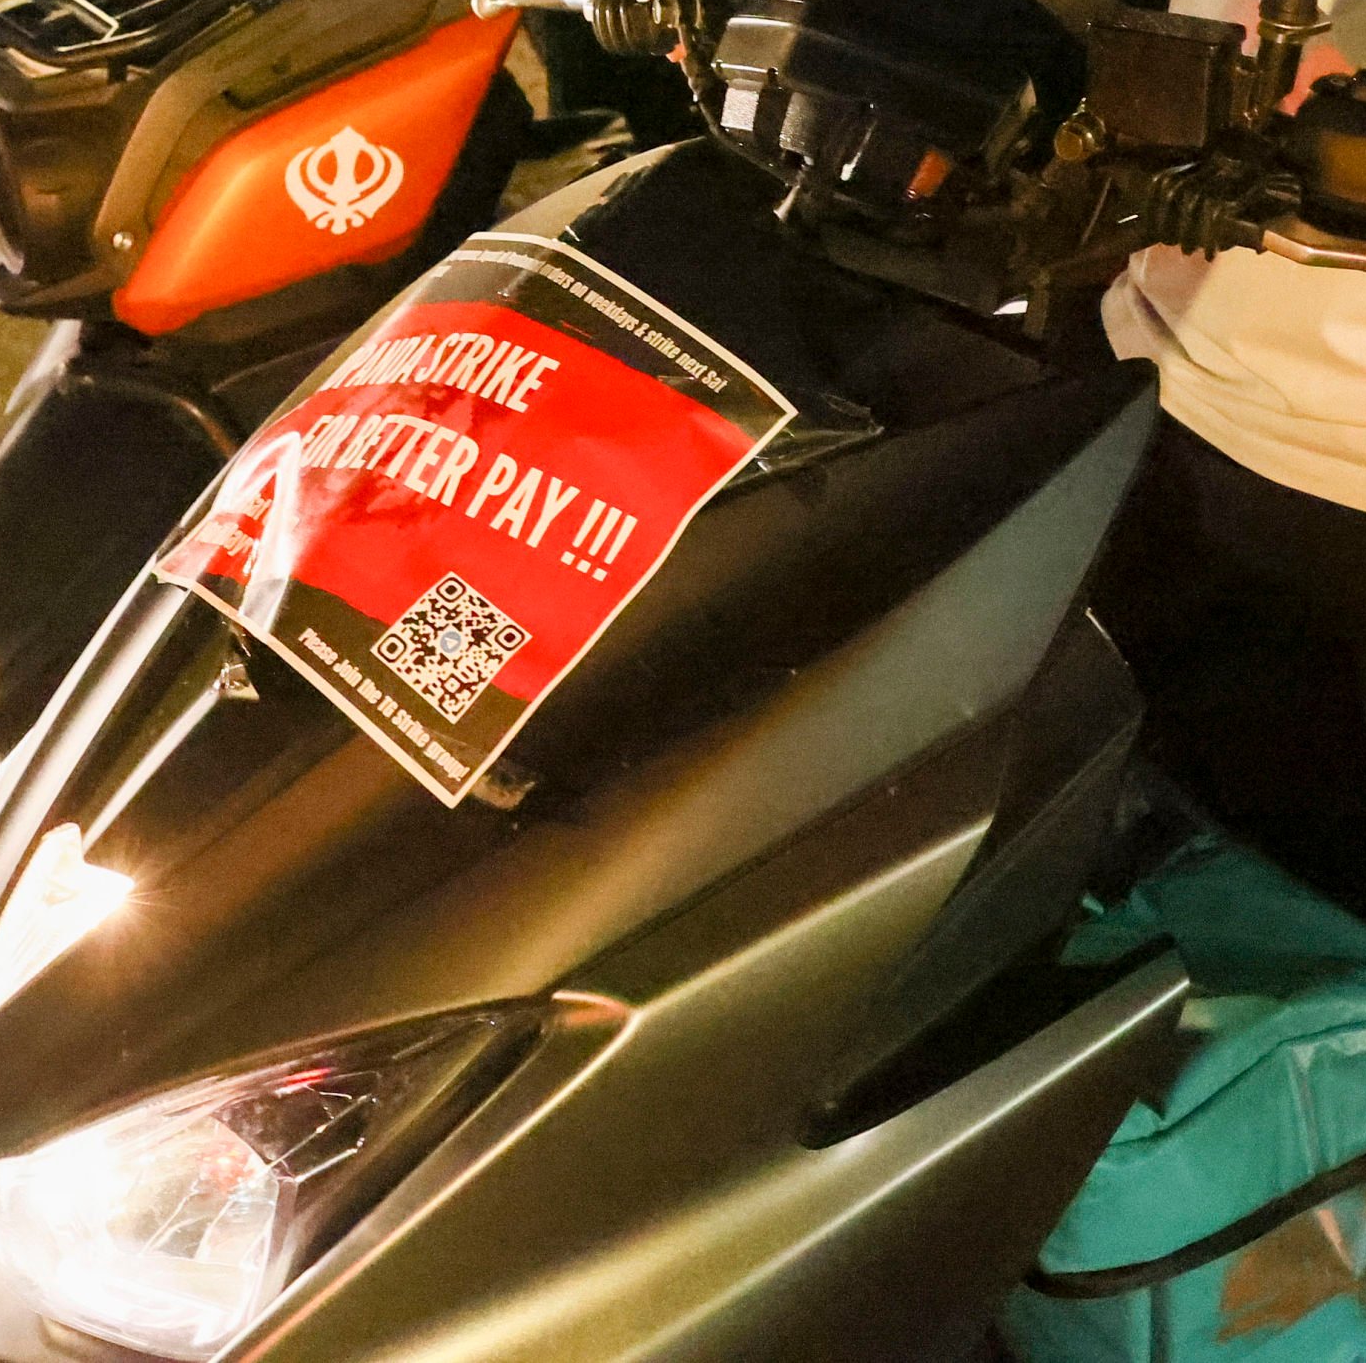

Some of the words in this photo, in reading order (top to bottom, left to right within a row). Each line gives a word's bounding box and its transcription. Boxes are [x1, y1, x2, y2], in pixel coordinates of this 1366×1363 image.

[415, 332, 561, 413] STRIKE
[569, 281, 588, 299] on
[584, 288, 639, 332] weekdays
[635, 323, 650, 339] &
[643, 330, 681, 360] strike
[675, 352, 707, 381] next
[702, 369, 730, 395] Sat
[300, 414, 360, 469] FOR
[336, 413, 480, 507] BETTER
[464, 452, 581, 548] PAY
[560, 498, 638, 582] !!!
[298, 627, 339, 665] Please
[332, 658, 363, 688] Join
[356, 678, 382, 704] the
[377, 695, 399, 718] TG
[391, 708, 430, 748] Strike
[423, 740, 471, 782] group!
